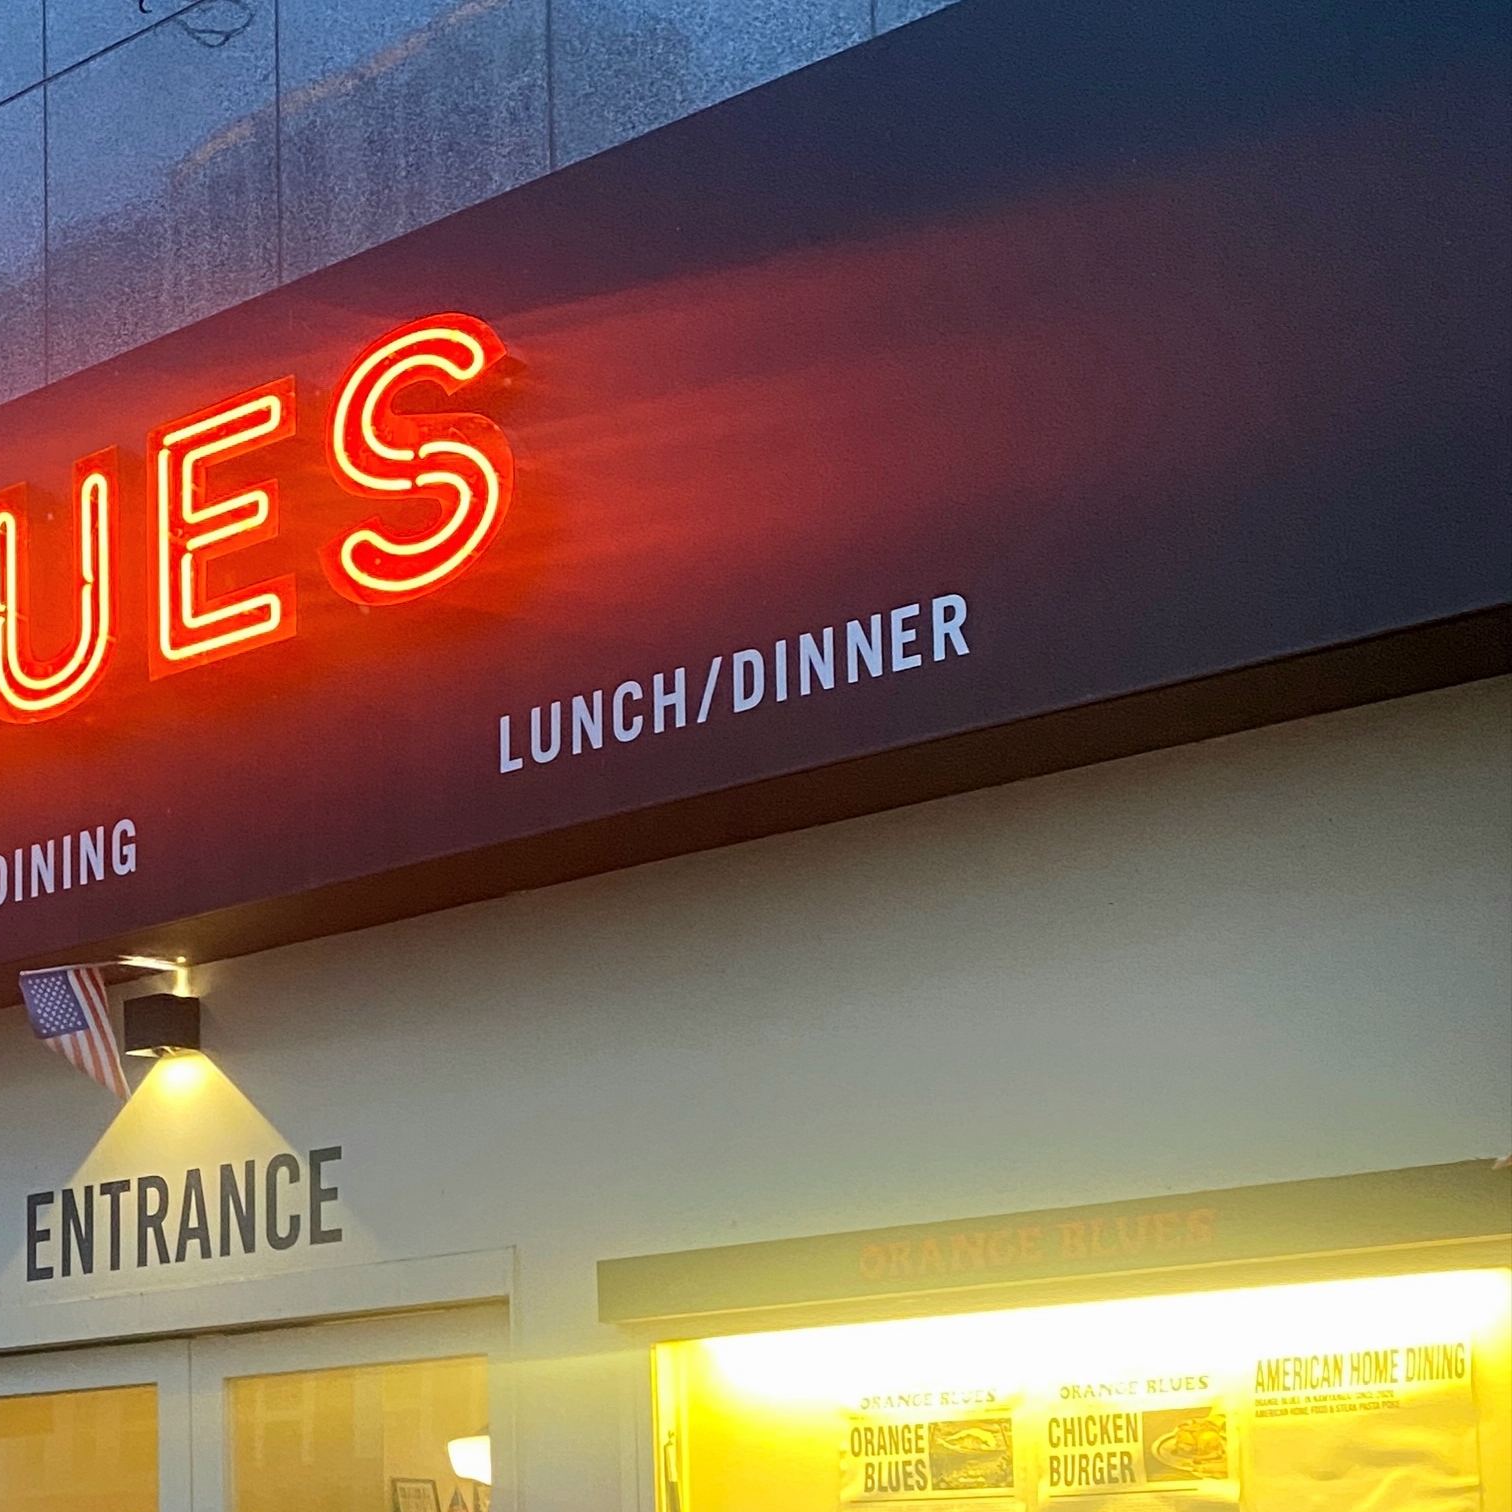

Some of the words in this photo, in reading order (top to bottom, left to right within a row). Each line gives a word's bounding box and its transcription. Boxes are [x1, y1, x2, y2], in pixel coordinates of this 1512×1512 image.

[499, 593, 970, 774] LUNCH/DINNER
[26, 1145, 342, 1282] ENTRANCE
[1255, 1353, 1344, 1393] AMERICAN
[1349, 1349, 1399, 1386] HOME
[1405, 1342, 1465, 1382] DINING
[850, 1423, 925, 1457] ORANGE
[1048, 1412, 1138, 1448] CHICKEN
[864, 1459, 928, 1493] BLUES
[1049, 1451, 1136, 1487] BURGER
